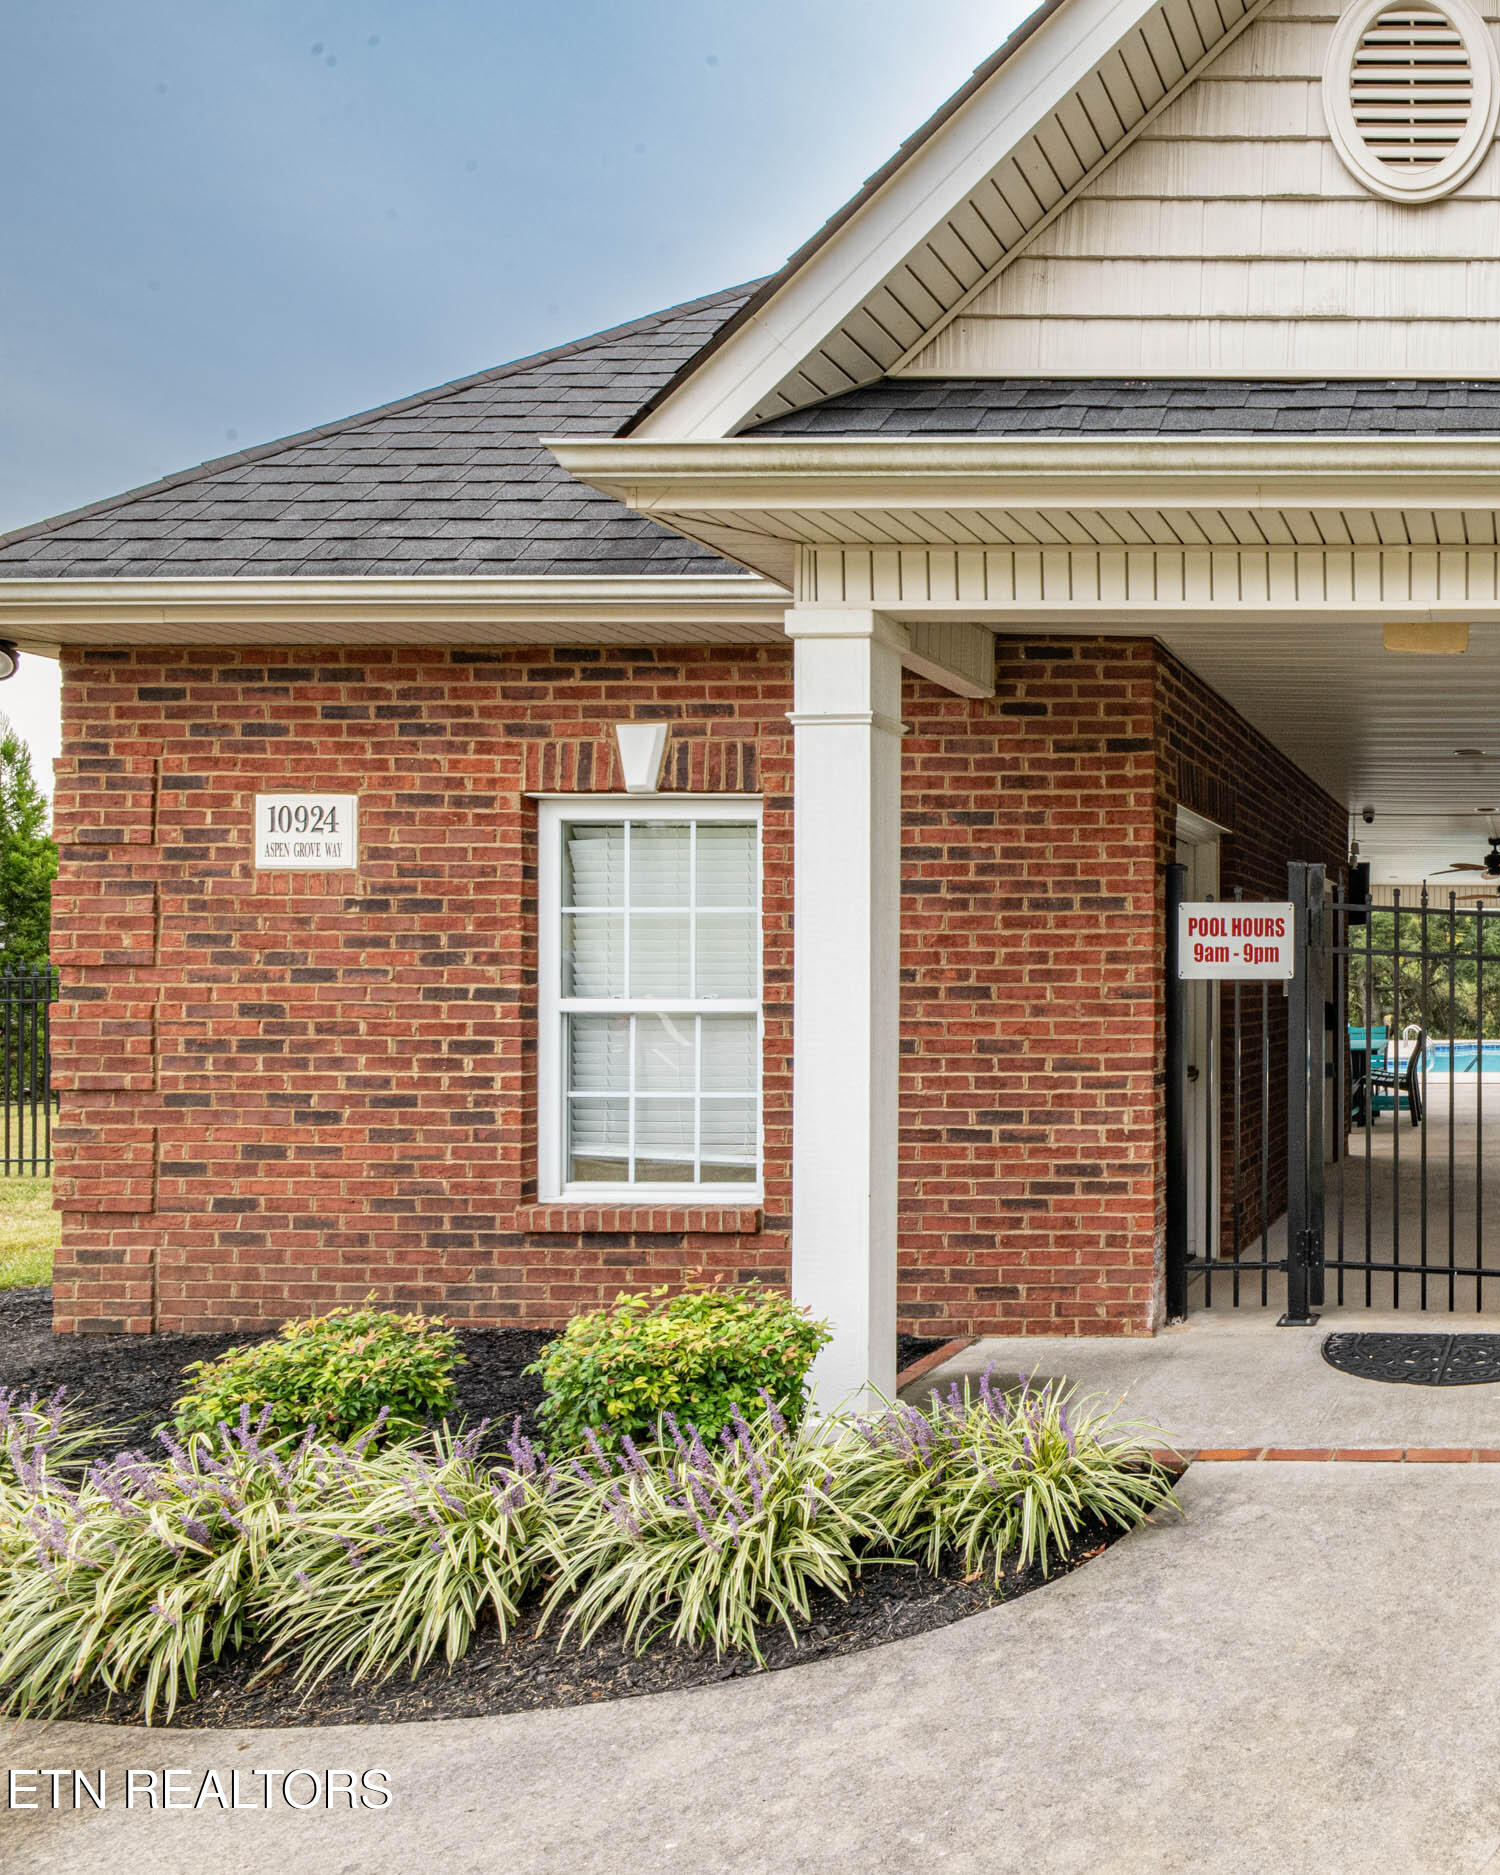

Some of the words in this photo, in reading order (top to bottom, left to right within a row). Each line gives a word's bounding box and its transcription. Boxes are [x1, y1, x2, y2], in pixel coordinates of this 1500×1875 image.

[267, 805, 340, 833] 10924
[264, 842, 290, 858] ASPEN
[293, 842, 321, 858] GROVE
[325, 842, 343, 858] WAY
[1188, 917, 1228, 937] POOL
[1231, 917, 1285, 937] HOURS
[1193, 943, 1230, 963] 9am
[1243, 943, 1280, 965] 9pm
